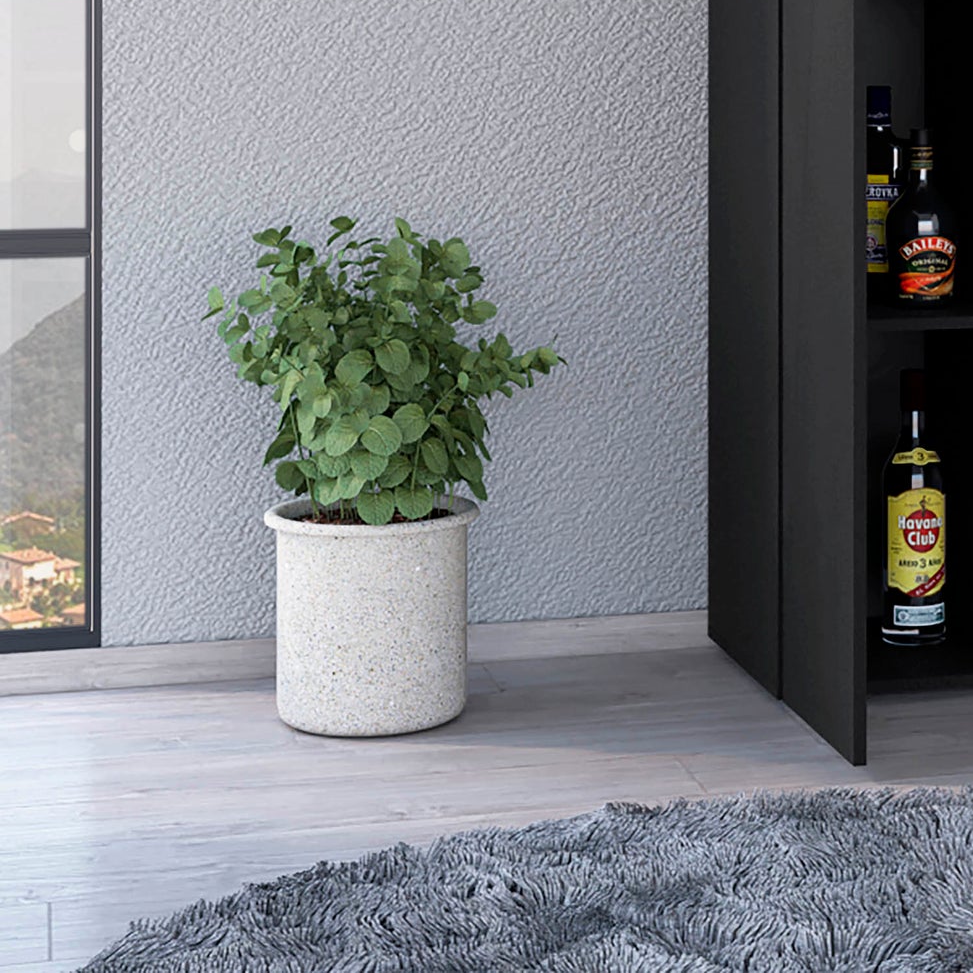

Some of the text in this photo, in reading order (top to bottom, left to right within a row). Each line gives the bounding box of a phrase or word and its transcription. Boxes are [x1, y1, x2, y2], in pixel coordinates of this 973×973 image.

[903, 238, 955, 256] BAILEYS
[898, 515, 943, 530] Havana
[907, 530, 936, 546] Club
[919, 558, 927, 569] 3
